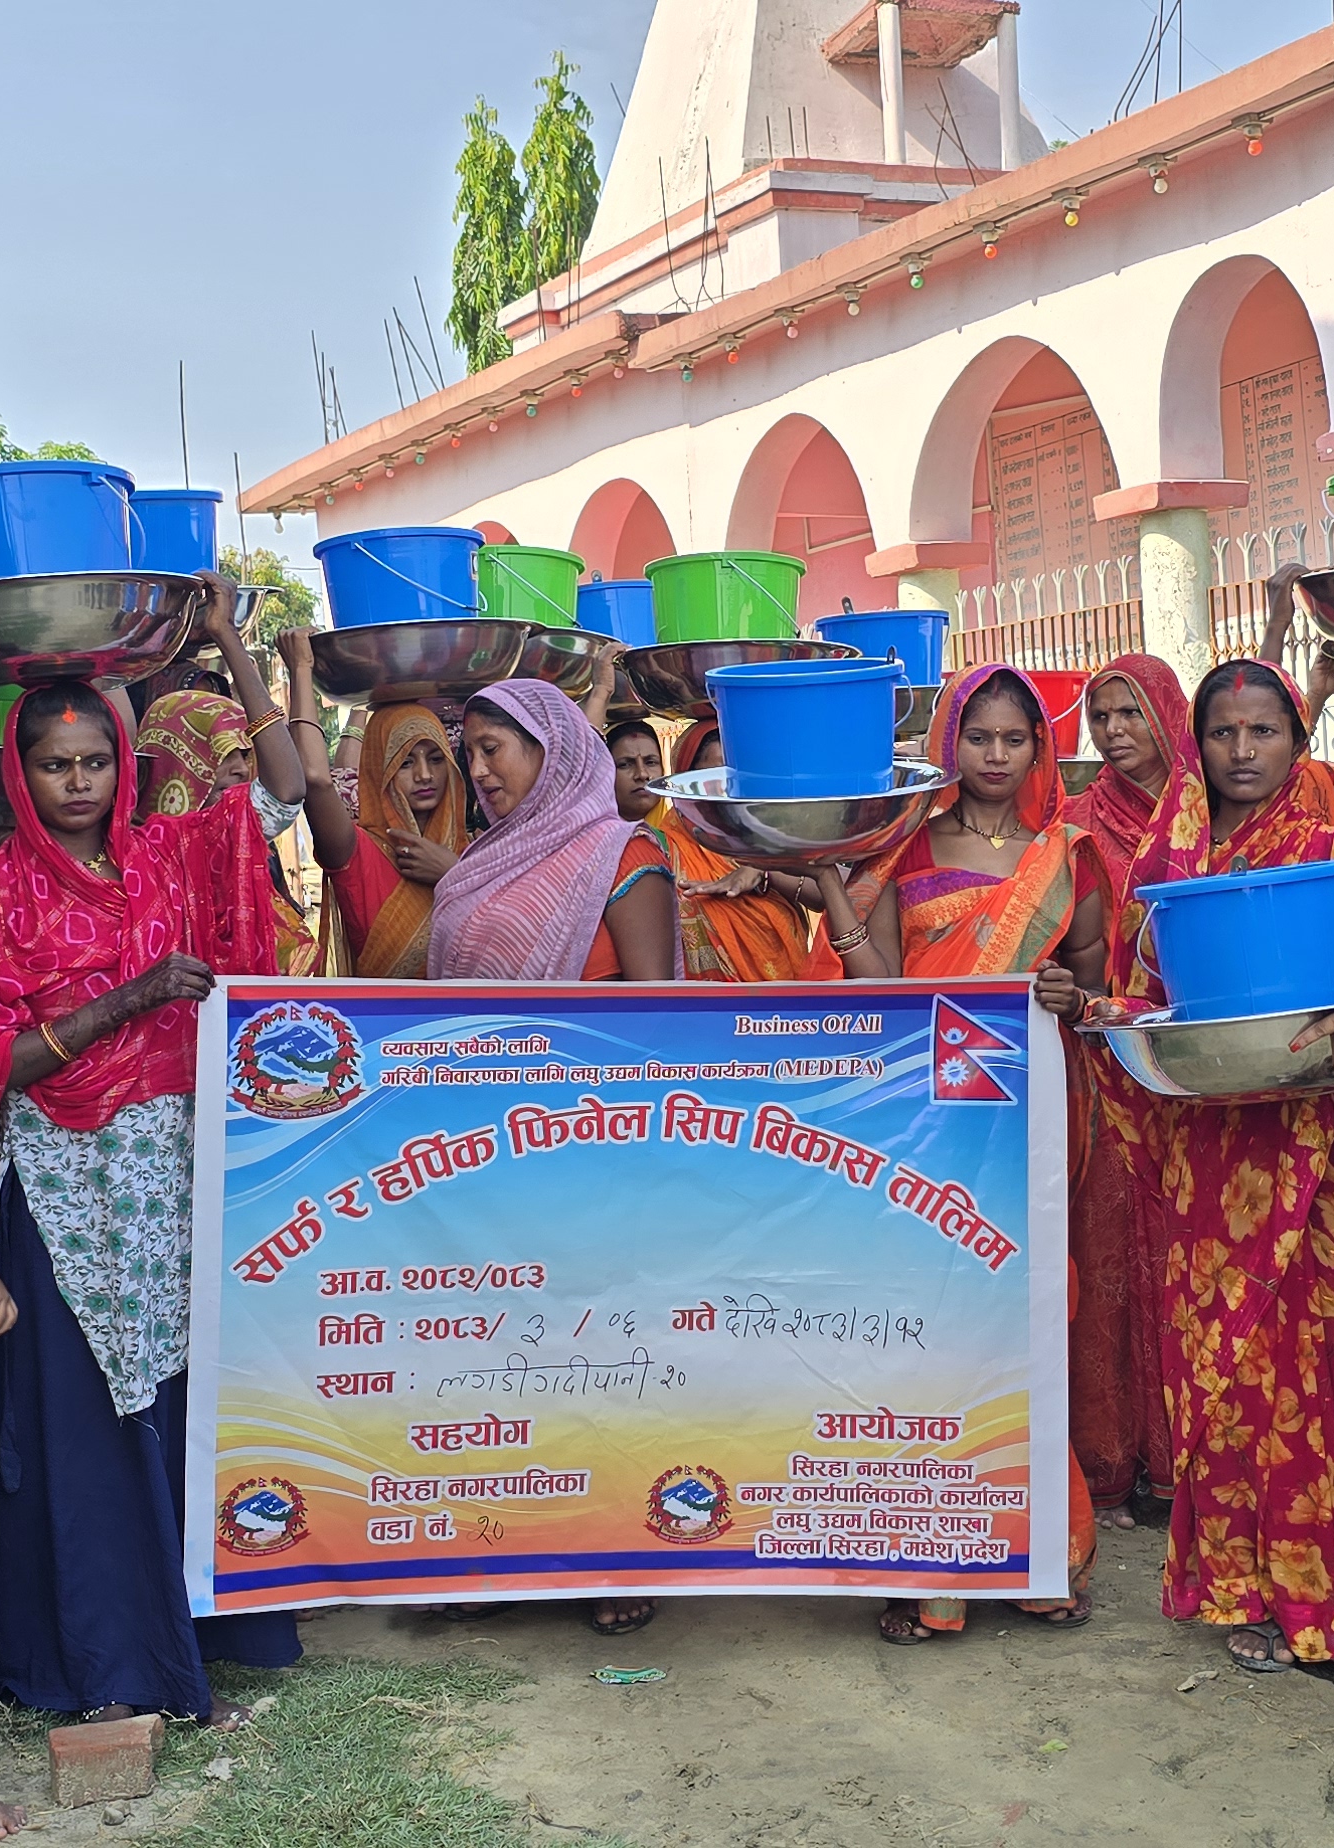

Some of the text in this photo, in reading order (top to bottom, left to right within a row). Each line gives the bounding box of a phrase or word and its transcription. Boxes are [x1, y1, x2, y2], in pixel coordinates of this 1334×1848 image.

[735, 1015, 882, 1034] Business Of All
[382, 1035, 549, 1056] व्यवसाय सबैको लागि
[381, 1058, 885, 1085] गरिबी निवारणका लागि लघु उद्यम विकास कार्यक्रम (MEDEPA)
[233, 1093, 1018, 1284] सर्फ र हर्पिक फिनेल सिप बिकास तालिम
[320, 1263, 545, 1296] आ.व. २०८२/०८३
[318, 1313, 386, 1347] मिति
[672, 1301, 718, 1332] गते
[317, 1371, 397, 1399] स्थान
[410, 1413, 532, 1451] सहयोग
[816, 1406, 962, 1442] आयोजक
[792, 1455, 974, 1480] सिरहा नगरपालिका
[370, 1468, 588, 1503] सिरहा नगरपालिका
[740, 1482, 1025, 1506] नगर कार्यपालिकाको कार्यालय
[370, 1519, 413, 1541] वडा
[427, 1513, 454, 1537] नं.
[776, 1509, 990, 1534] लघु उद्यम विकास शाखा
[758, 1534, 822, 1555] जिल्ला
[828, 1535, 886, 1557] सिरहा
[960, 1539, 1007, 1561] प्रदेश
